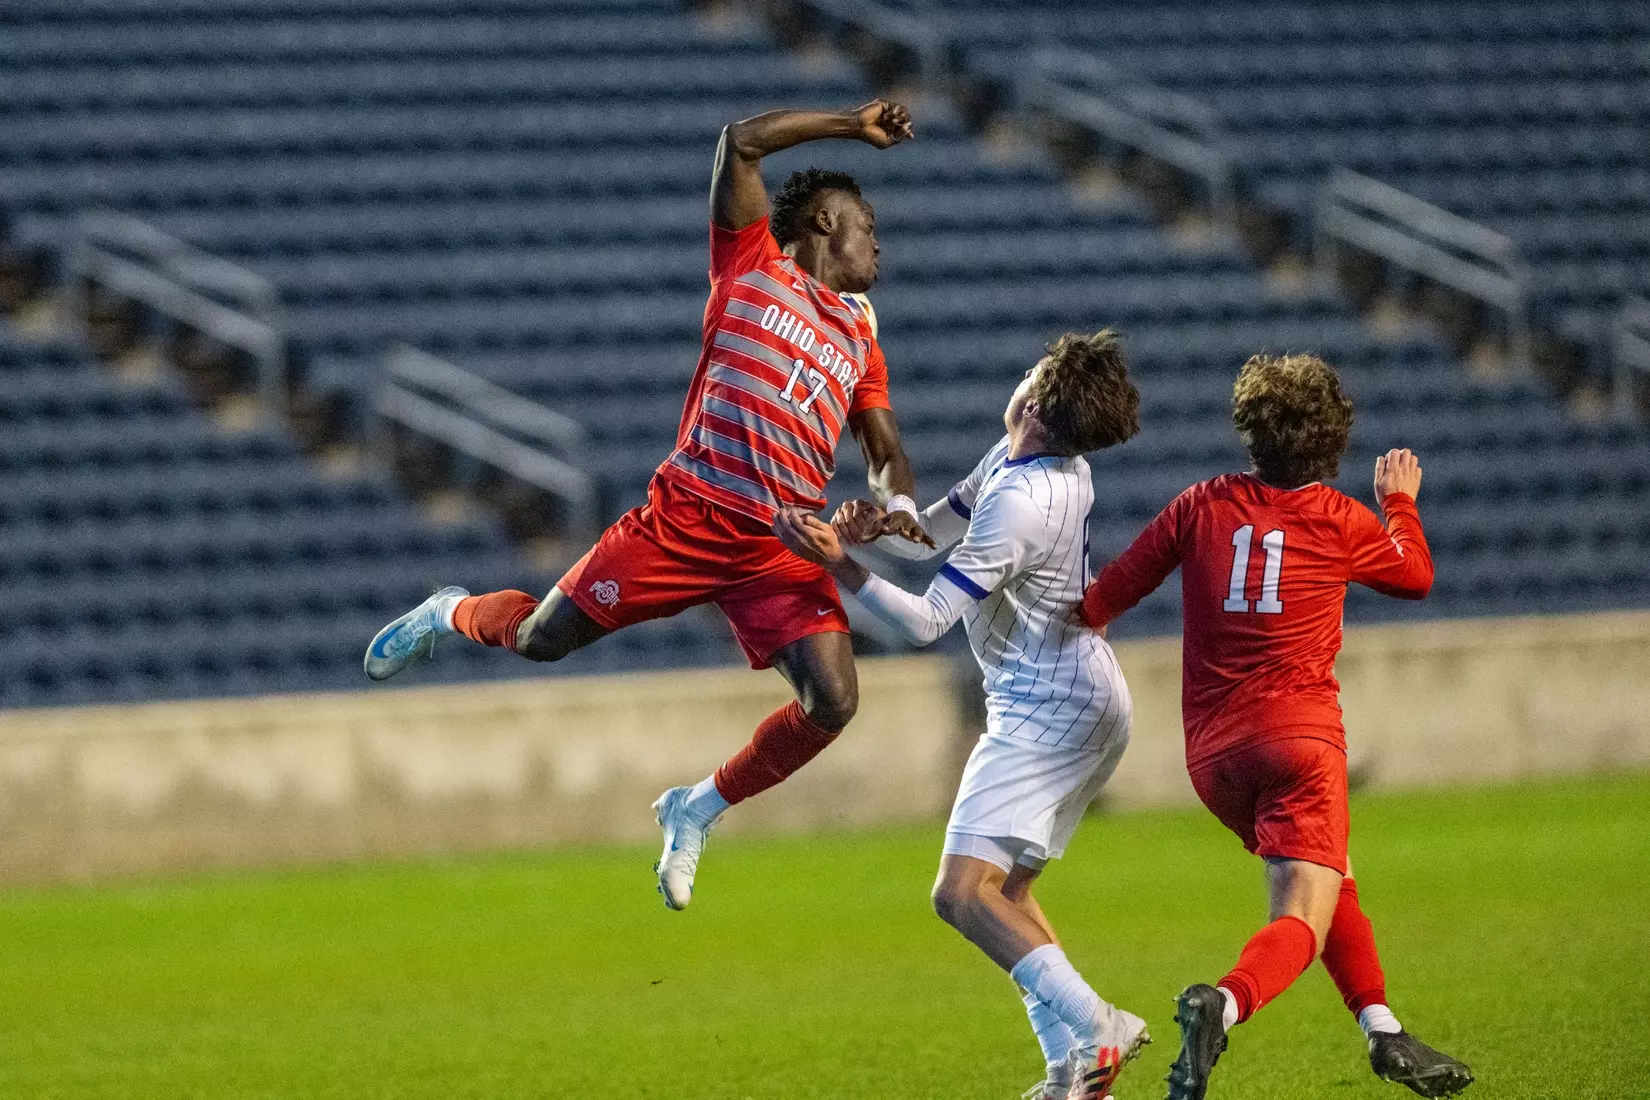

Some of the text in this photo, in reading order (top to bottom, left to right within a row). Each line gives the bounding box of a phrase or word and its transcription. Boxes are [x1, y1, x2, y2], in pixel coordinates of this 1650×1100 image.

[761, 304, 816, 352] OHIO
[779, 358, 828, 415] 17
[1223, 524, 1285, 614] 11
